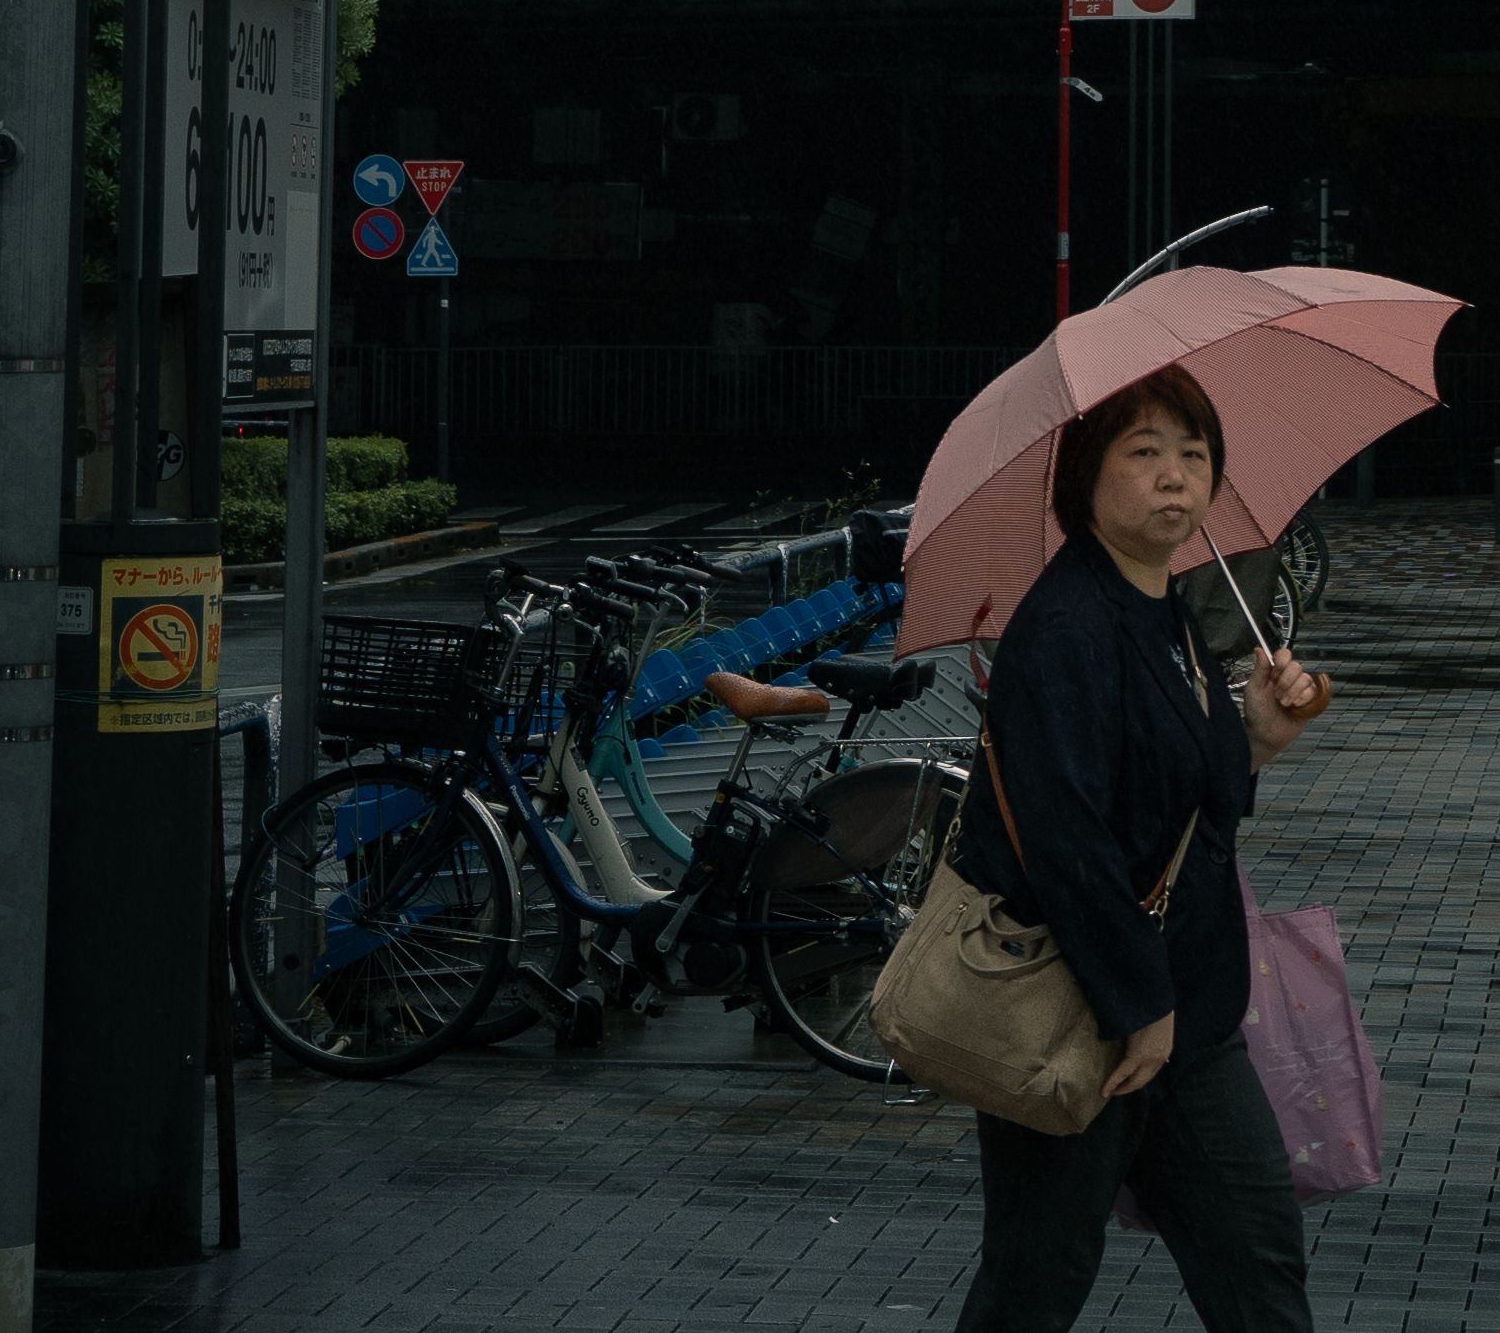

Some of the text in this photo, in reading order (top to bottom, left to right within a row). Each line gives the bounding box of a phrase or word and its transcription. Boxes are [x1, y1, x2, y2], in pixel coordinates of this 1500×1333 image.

[415, 167, 452, 180] 止まれ
[421, 181, 447, 192] STOP
[60, 603, 82, 617] 375
